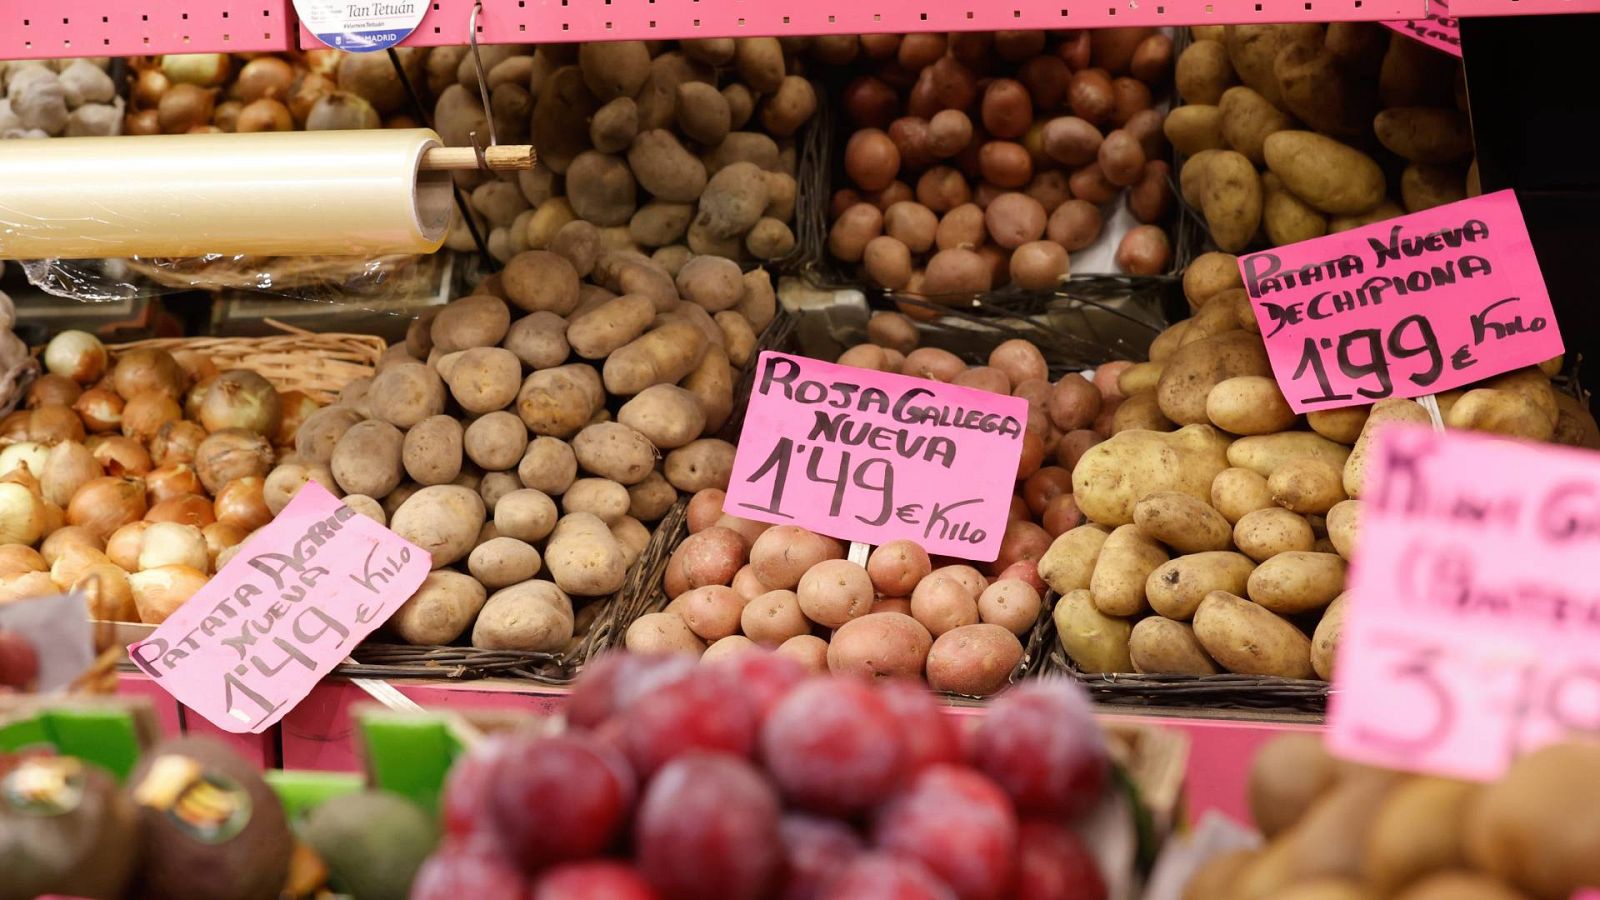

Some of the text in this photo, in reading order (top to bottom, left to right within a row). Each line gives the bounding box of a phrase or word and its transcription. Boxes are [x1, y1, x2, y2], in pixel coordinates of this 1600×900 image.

[346, 4, 369, 18] Tan
[372, 0, 415, 17] Tetuán
[363, 33, 397, 42] MADRID
[1243, 219, 1490, 298] PATATA NUEVA
[758, 356, 1022, 440] ROJA GALLEGA
[807, 410, 957, 469] NUEVA
[131, 583, 264, 678] PATATA
[220, 566, 330, 661] NUEVA
